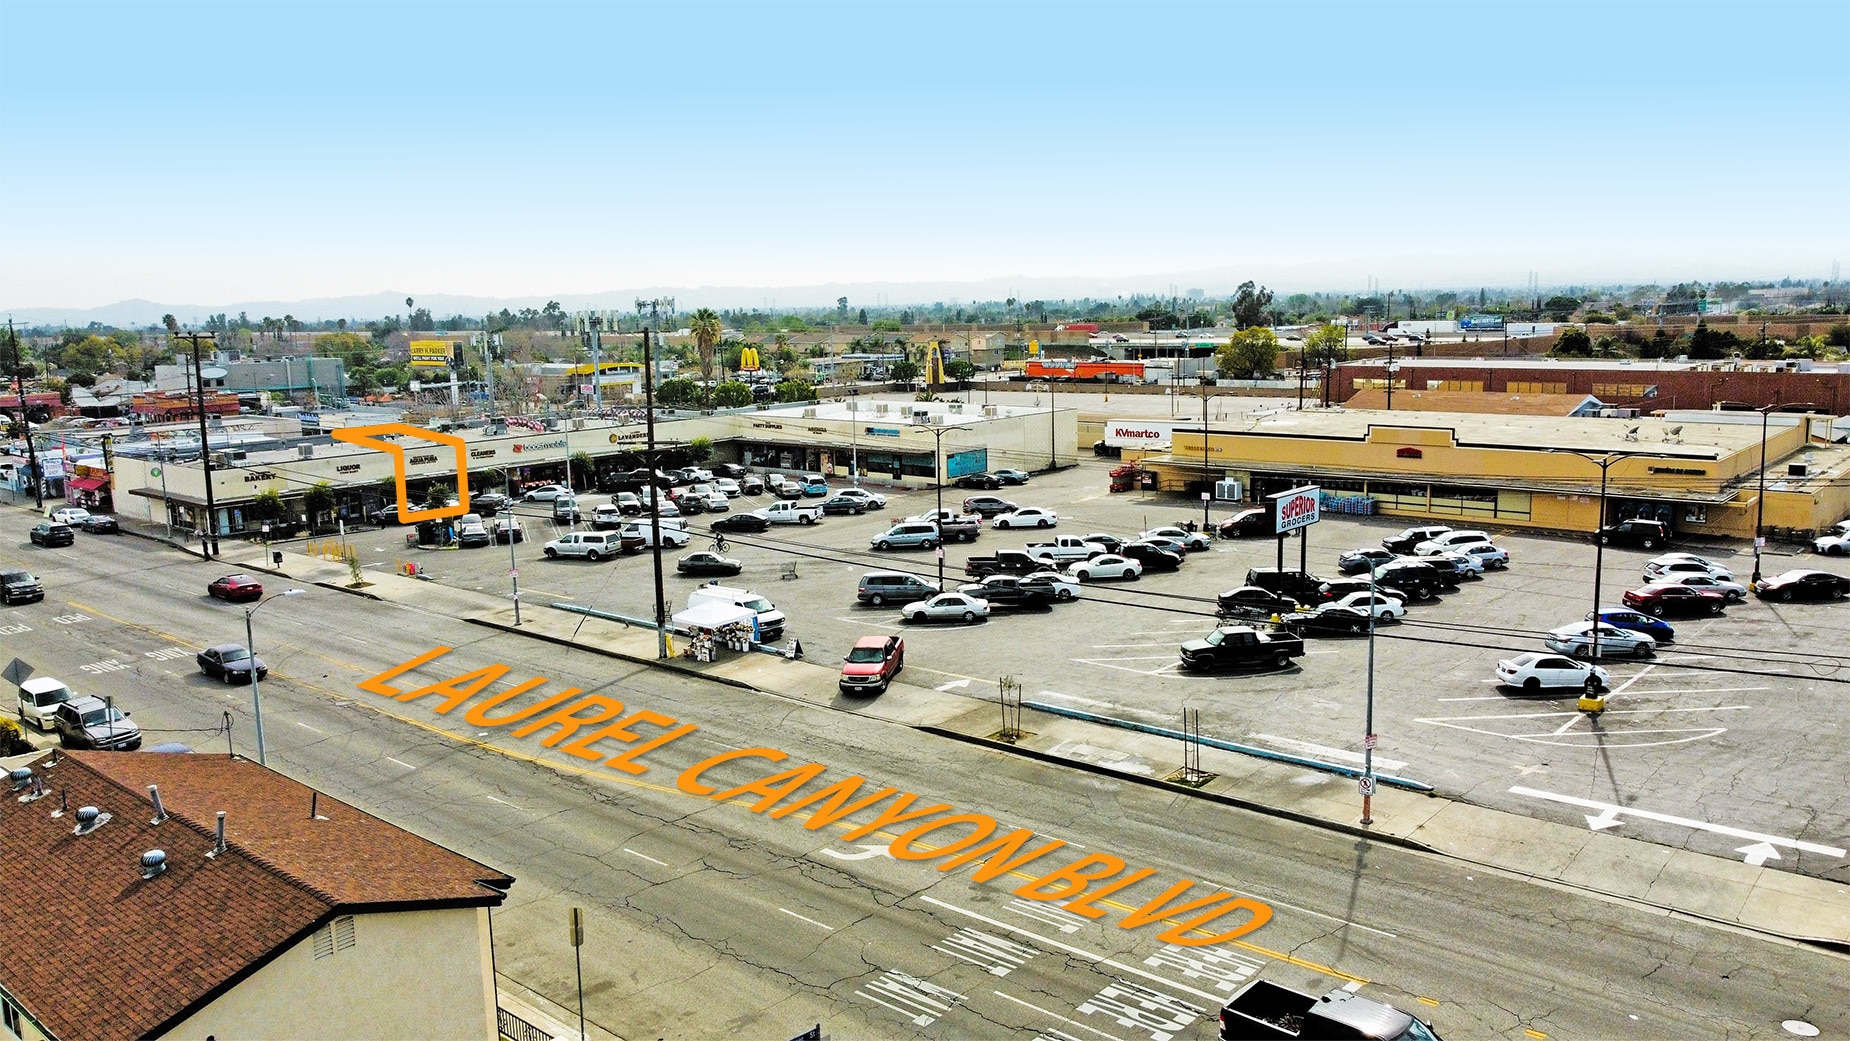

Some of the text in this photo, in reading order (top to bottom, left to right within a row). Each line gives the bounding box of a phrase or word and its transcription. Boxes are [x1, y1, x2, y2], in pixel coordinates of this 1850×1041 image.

[430, 347, 446, 355] PARKER
[1115, 428, 1160, 439] KVmartco
[471, 449, 496, 457] CLEANERS
[336, 463, 361, 472] LIQUOR
[244, 472, 277, 482] BAKERY
[1281, 495, 1316, 520] SUPERIOR
[1281, 512, 1316, 529] GROCERS
[53, 613, 92, 625] PED
